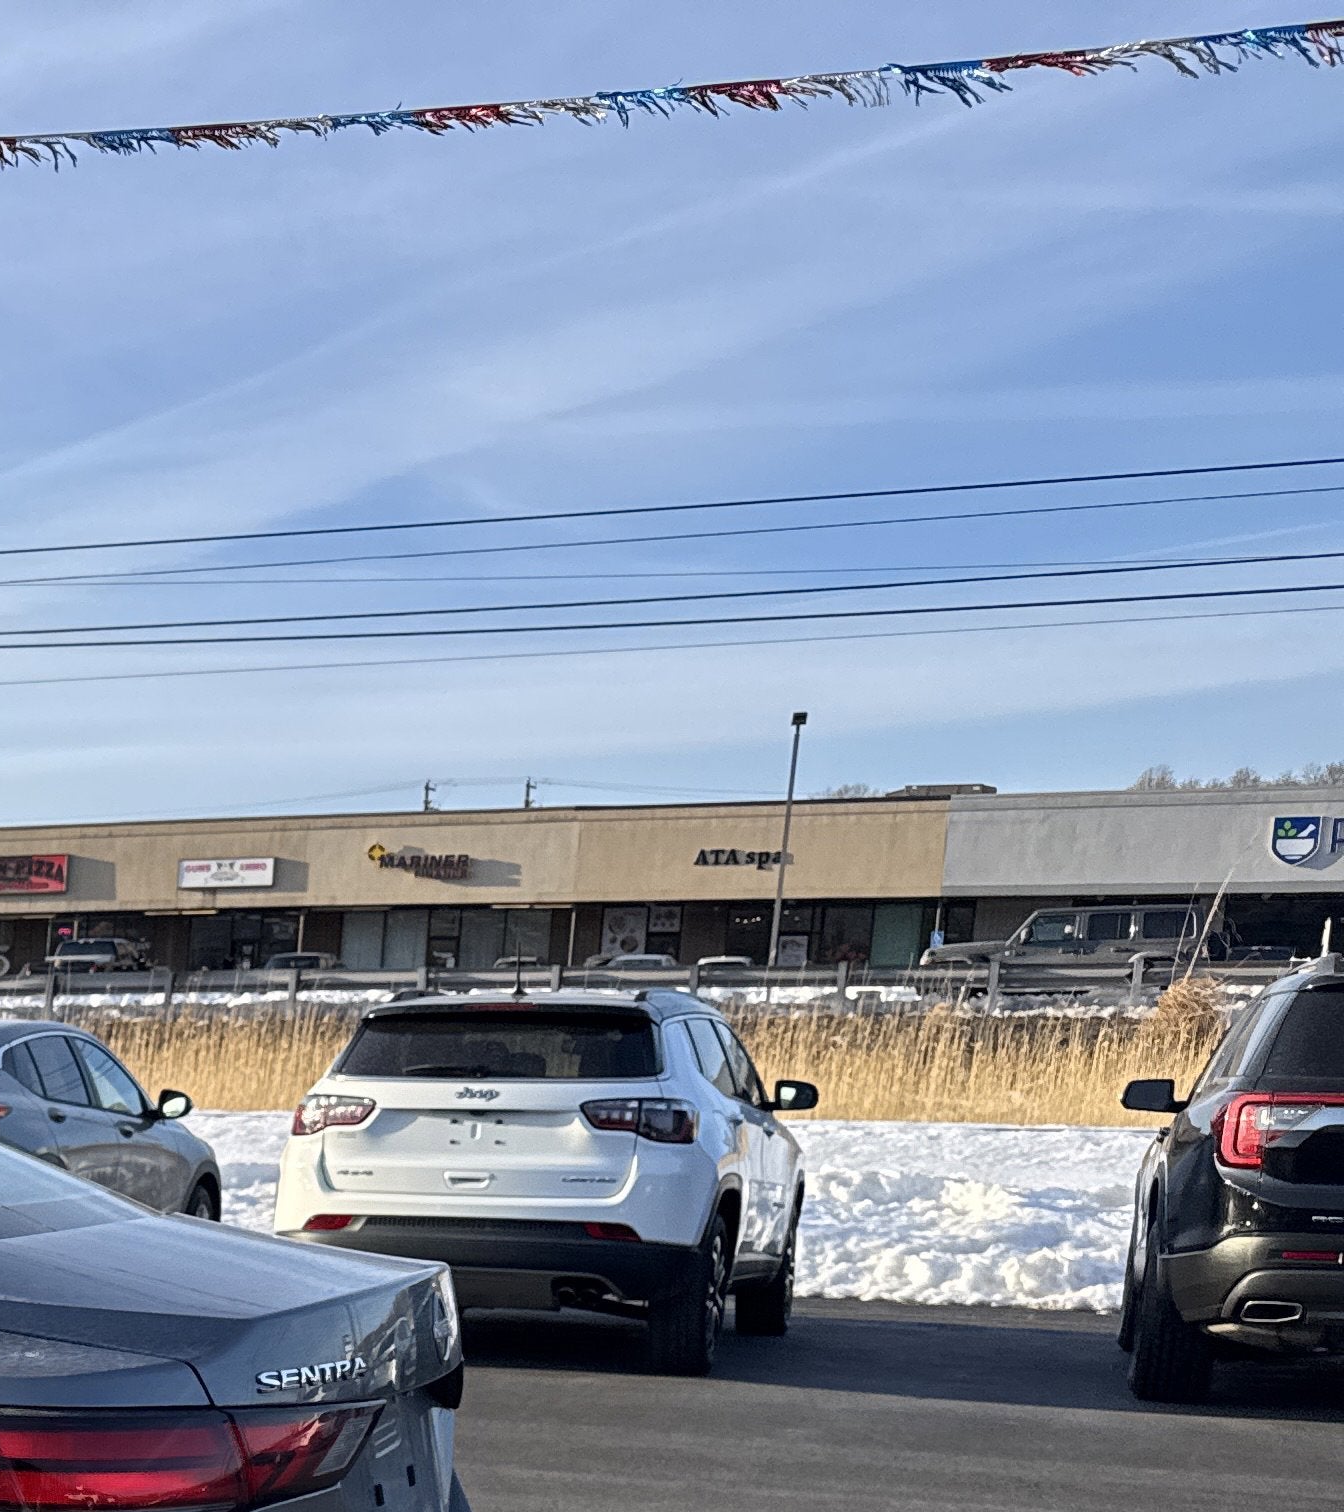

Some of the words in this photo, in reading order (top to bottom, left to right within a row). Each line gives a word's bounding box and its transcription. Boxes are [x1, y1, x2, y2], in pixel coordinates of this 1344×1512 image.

[379, 854, 470, 868] MARINER
[694, 849, 740, 865] ATA
[455, 1086, 500, 1102] Jeep
[256, 1357, 367, 1392] SENTRA
